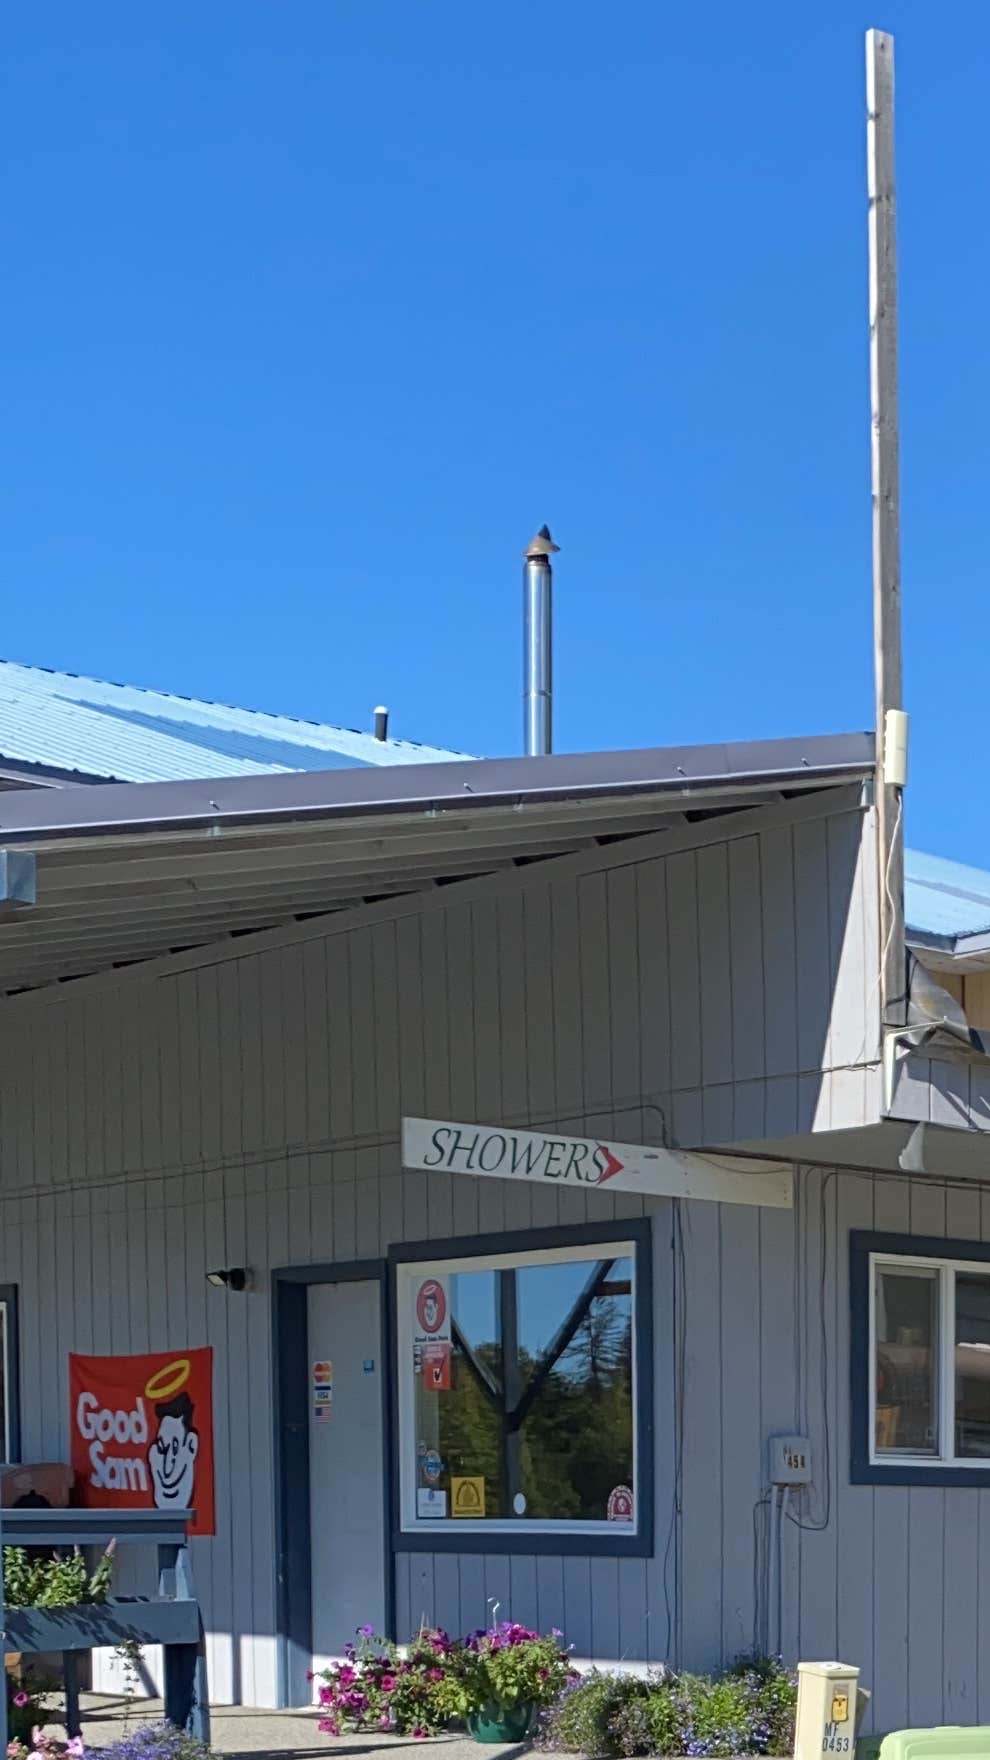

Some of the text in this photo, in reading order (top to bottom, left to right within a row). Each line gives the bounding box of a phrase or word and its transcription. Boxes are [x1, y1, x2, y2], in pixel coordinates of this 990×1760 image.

[424, 1128, 603, 1183] SHOWERS
[77, 1392, 147, 1443] Good
[89, 1441, 147, 1490] Sam
[822, 1737, 849, 1752] 0453
